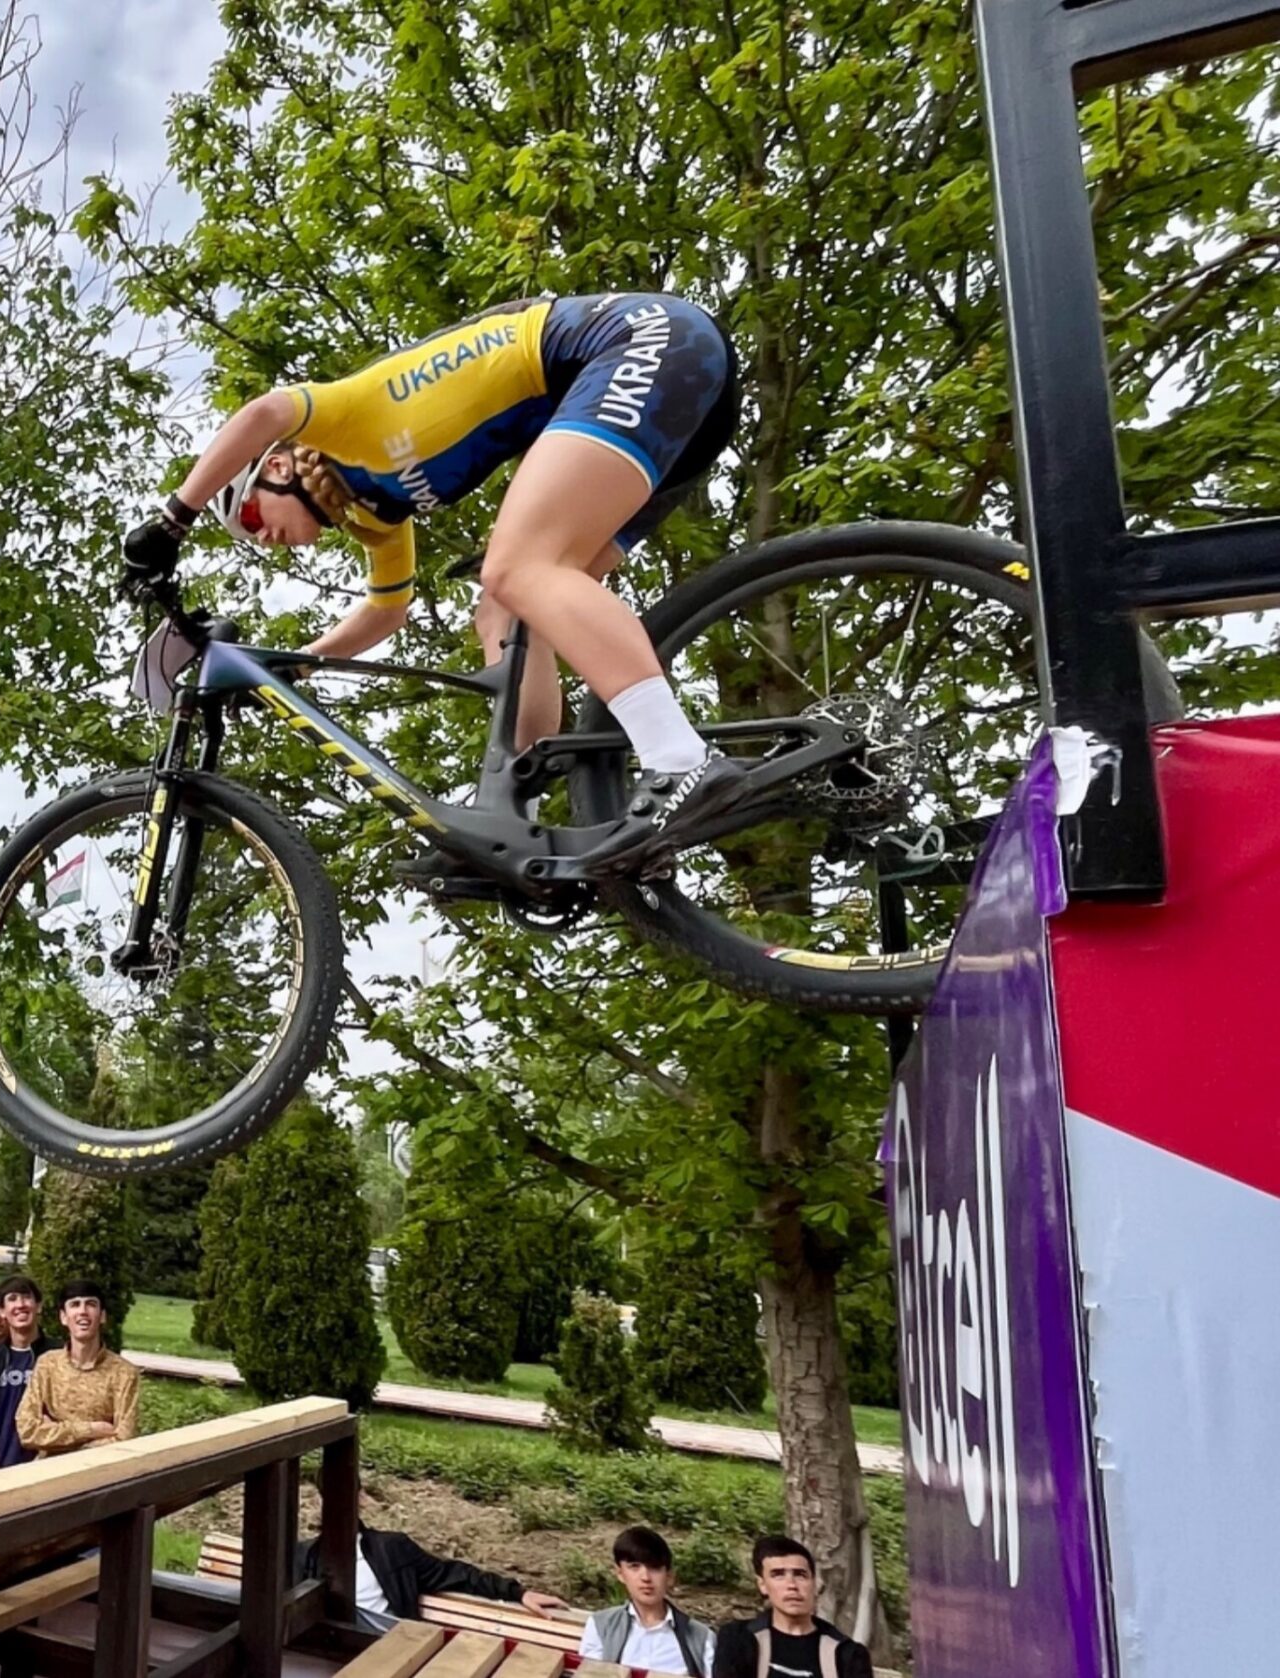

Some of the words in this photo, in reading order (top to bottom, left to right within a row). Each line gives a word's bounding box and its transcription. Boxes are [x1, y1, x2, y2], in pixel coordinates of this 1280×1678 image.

[387, 324, 518, 402] UKRAINE
[596, 302, 671, 429] UKRAINE
[382, 428, 441, 512] RAINE
[76, 1139, 177, 1160] MAXXIS
[919, 1053, 1020, 1588] tcell
